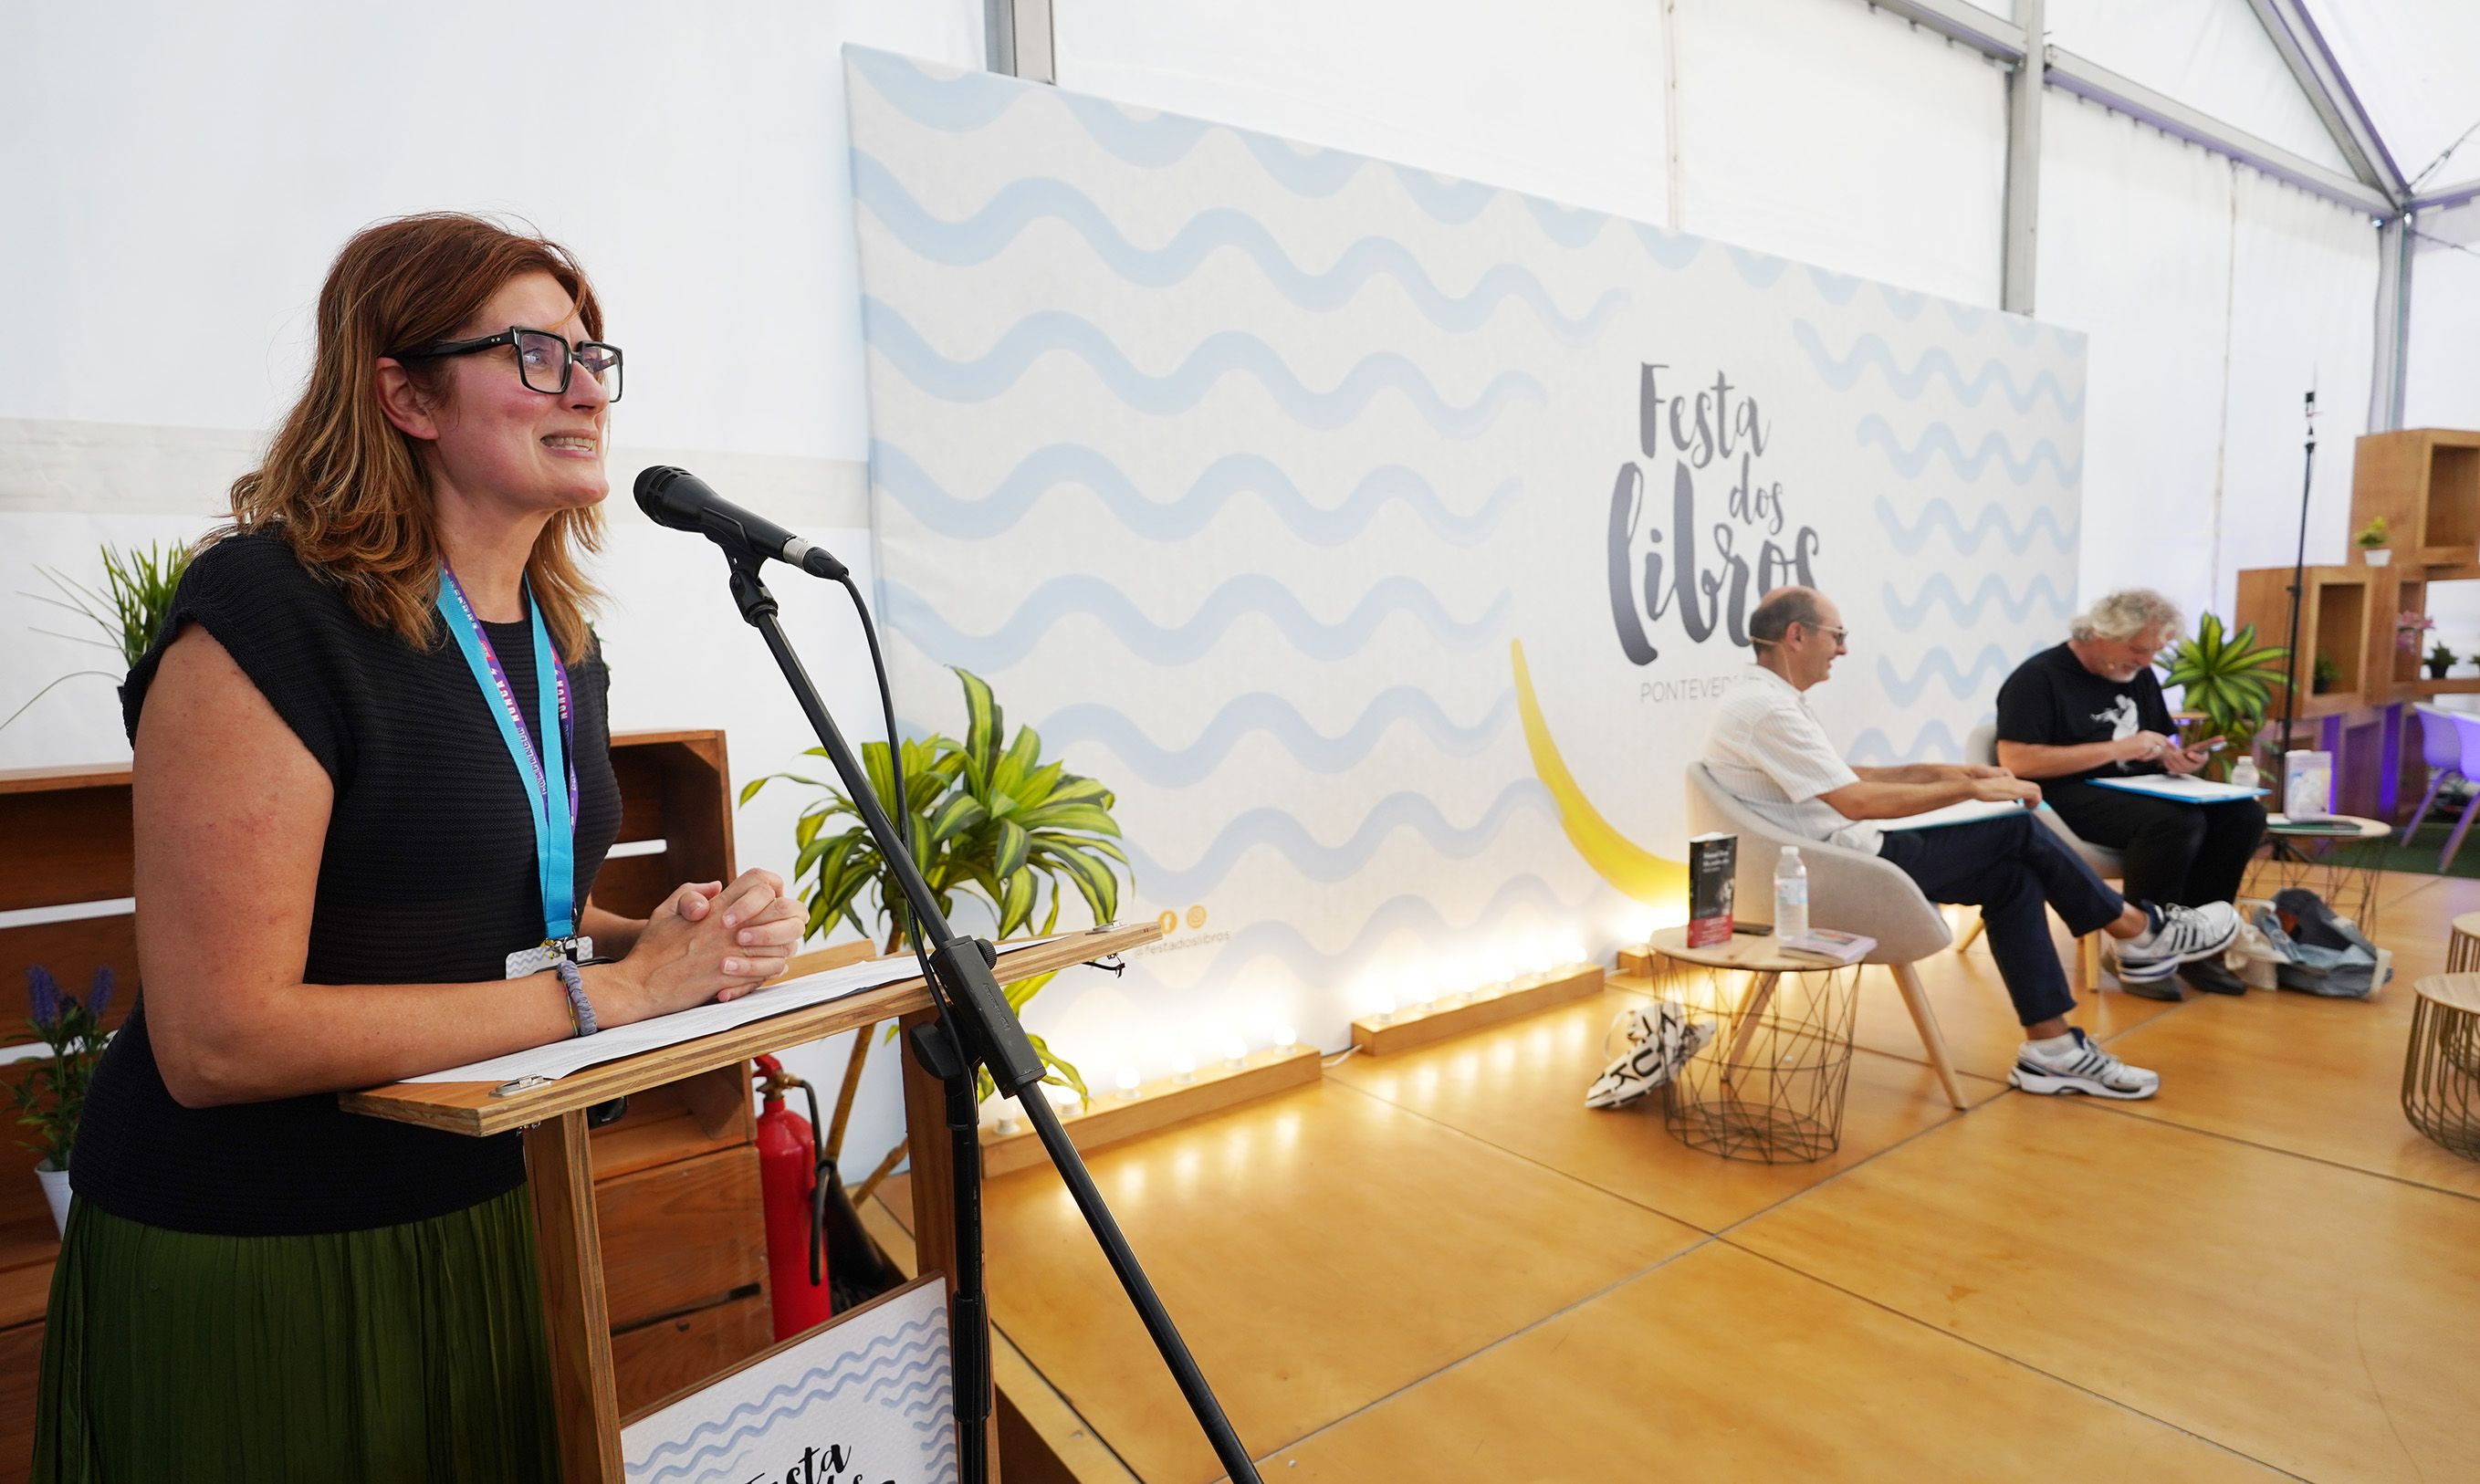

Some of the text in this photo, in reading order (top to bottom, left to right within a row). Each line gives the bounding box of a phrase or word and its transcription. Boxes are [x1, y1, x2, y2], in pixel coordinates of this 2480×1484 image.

[1640, 361, 1771, 469] Festa
[1730, 452, 1784, 535] dos
[495, 680, 520, 722] NUNCA
